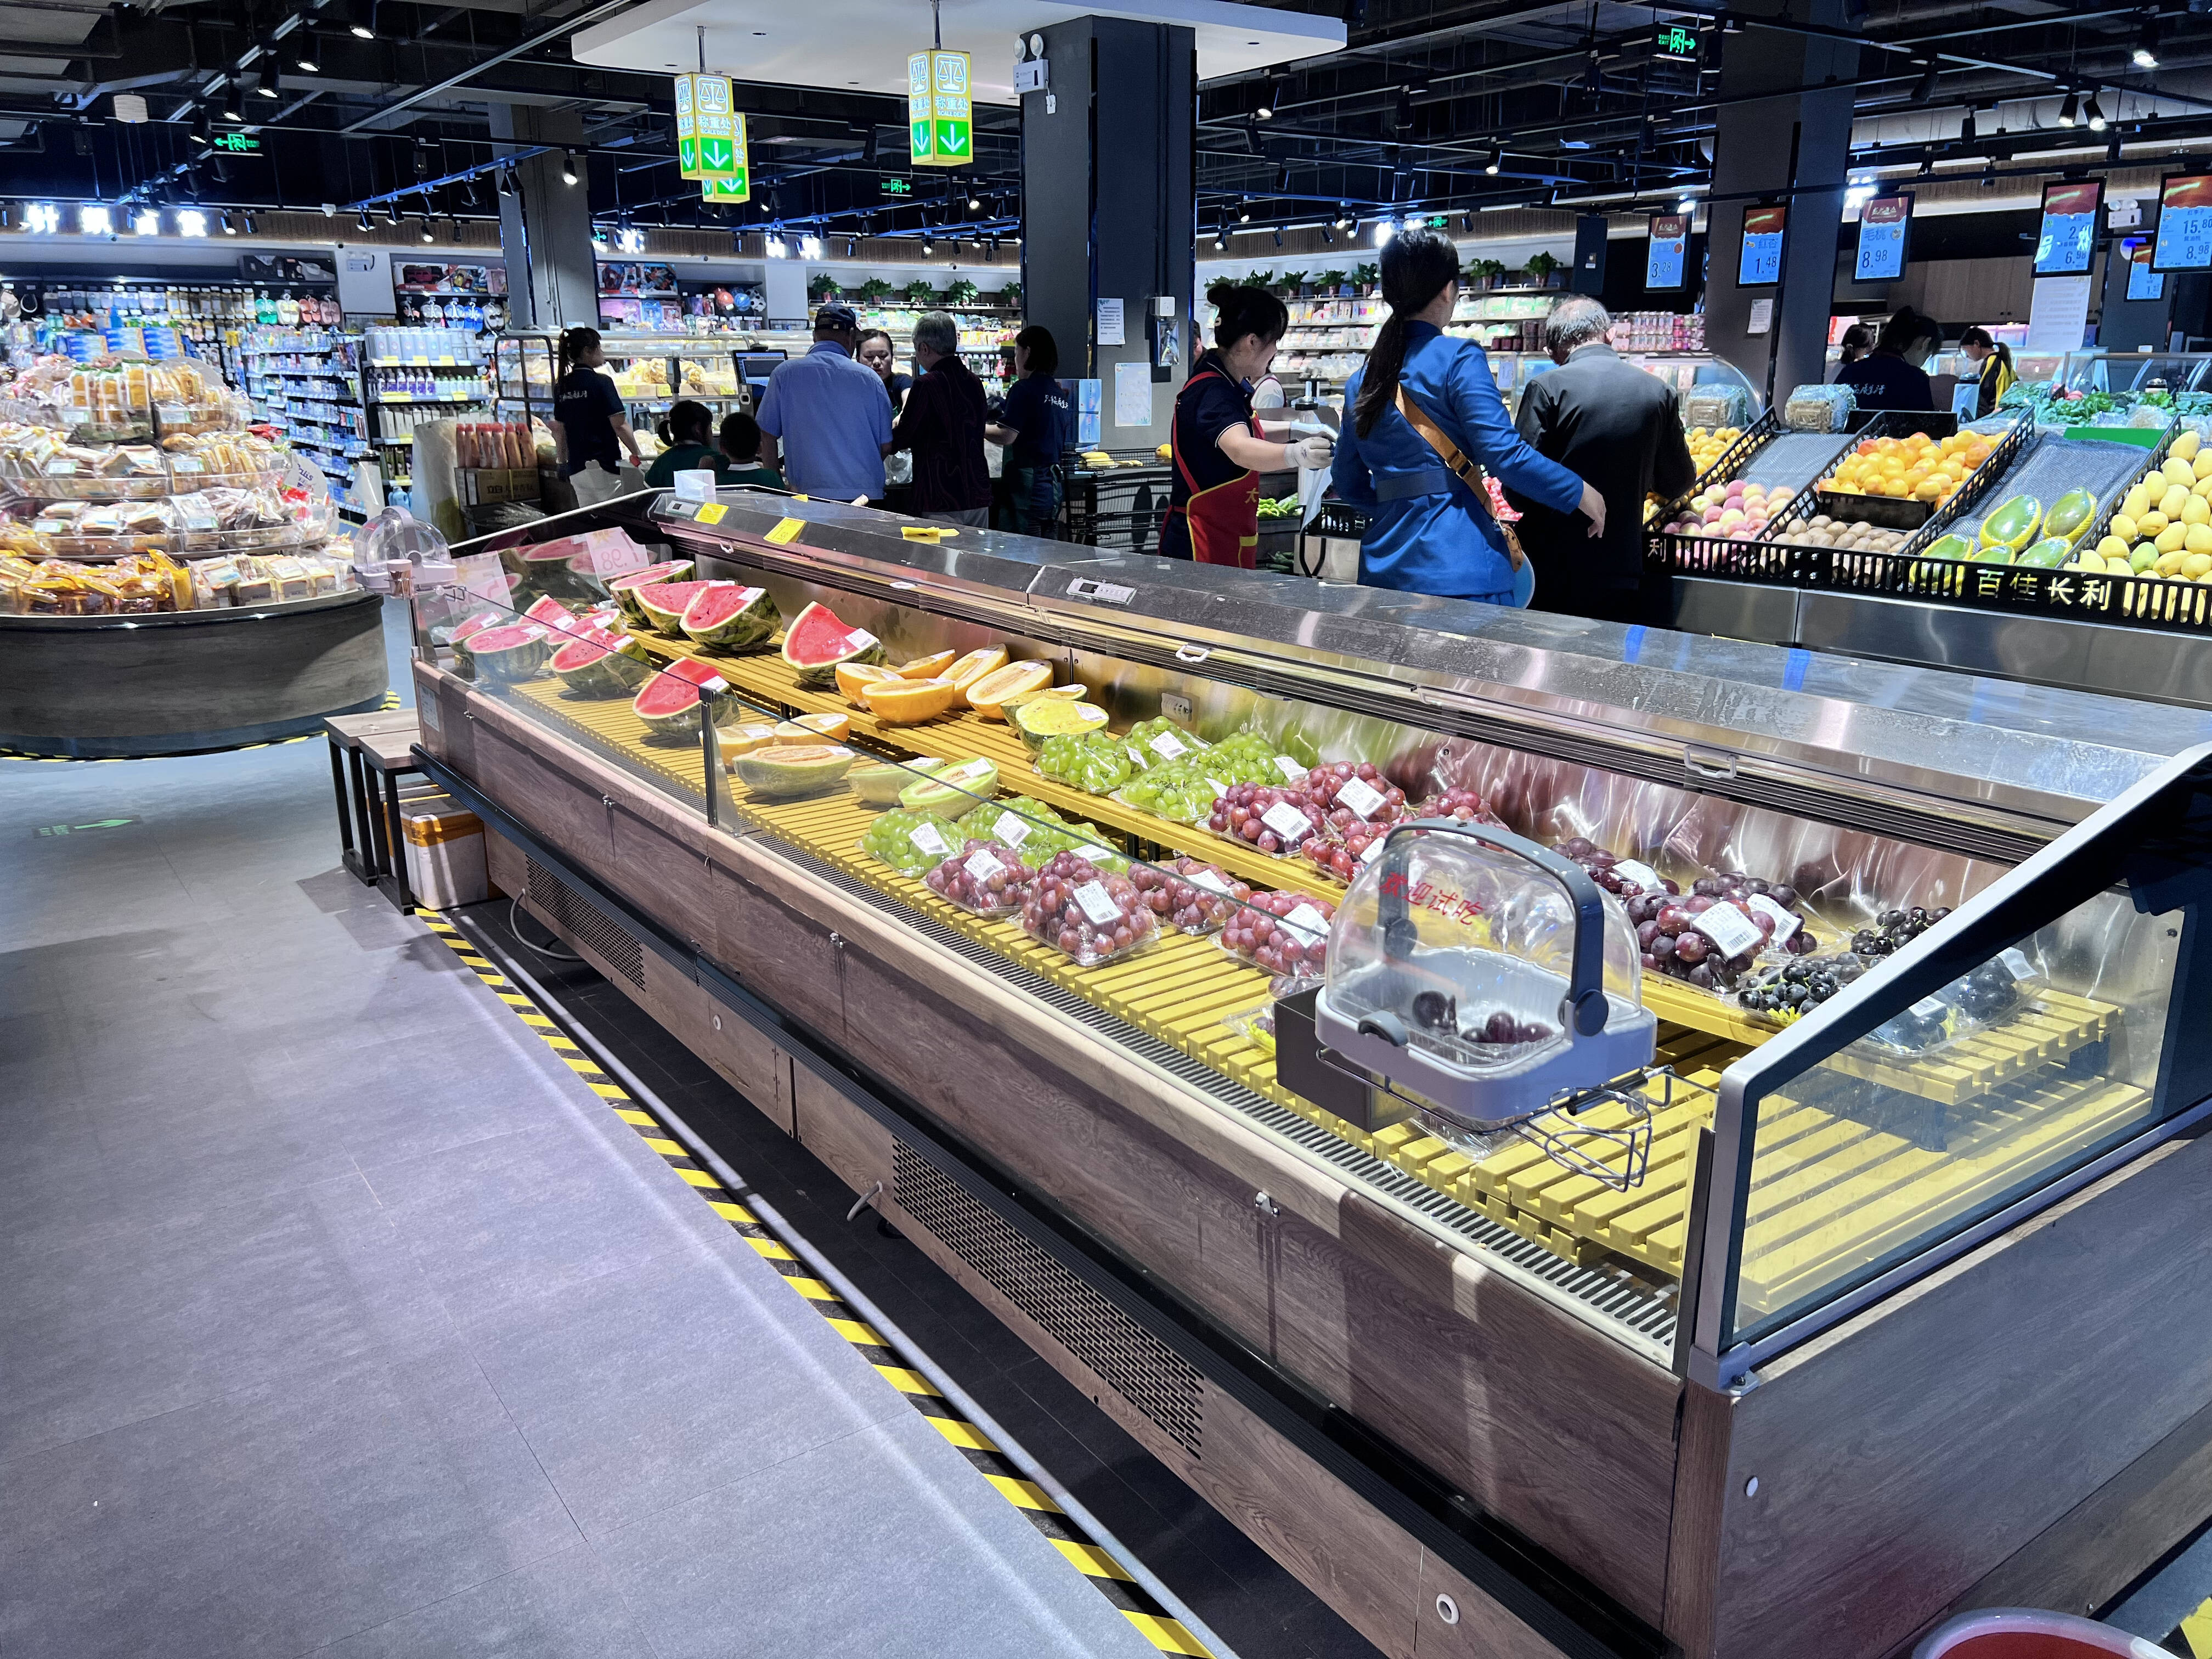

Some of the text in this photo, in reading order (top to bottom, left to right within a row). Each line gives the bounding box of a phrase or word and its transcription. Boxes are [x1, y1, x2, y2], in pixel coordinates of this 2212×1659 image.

[935, 95, 968, 111] 称重处
[697, 115, 731, 129] 称重处
[2183, 218, 2212, 234] 15.80
[1864, 228, 1886, 241] 毛桃
[1862, 249, 1888, 268] 8.98
[2186, 245, 2210, 259] 8.98
[1651, 262, 1672, 278] 3.28
[1756, 256, 1777, 274] 1.48
[1977, 568, 2112, 611] 百佳长利
